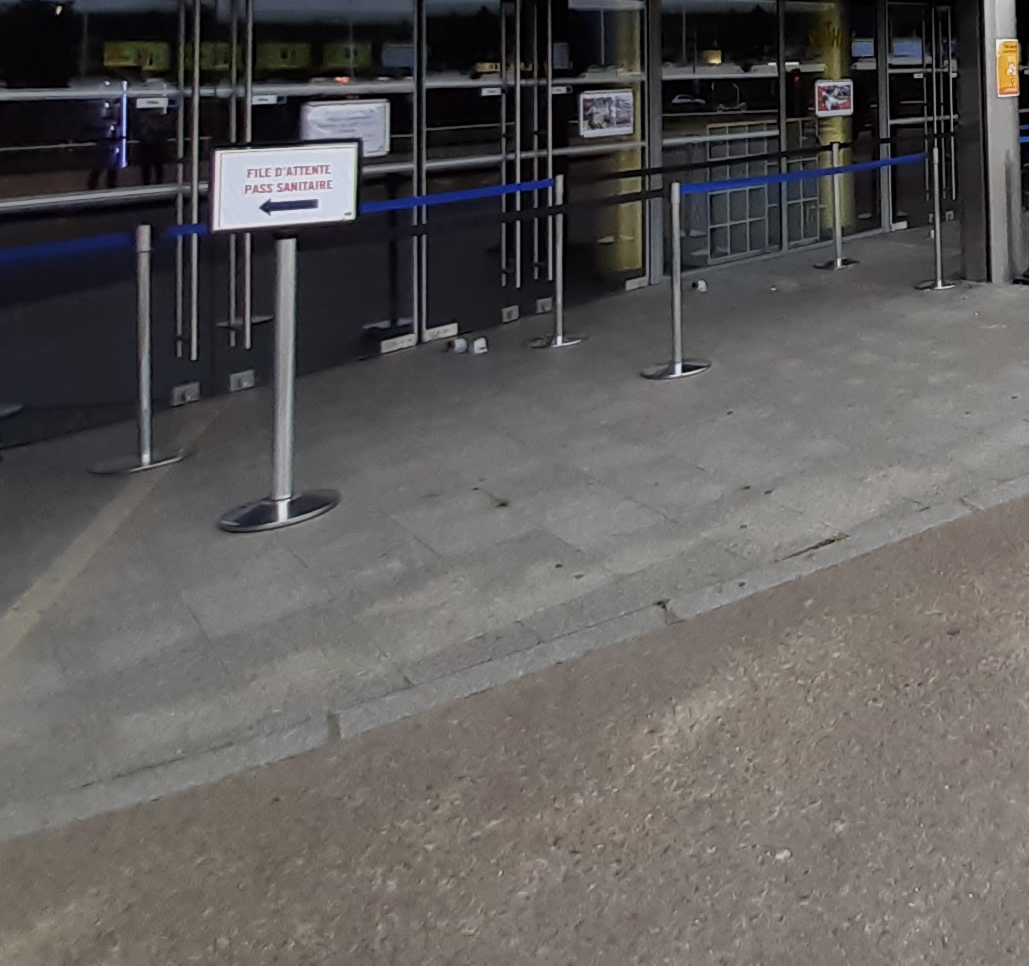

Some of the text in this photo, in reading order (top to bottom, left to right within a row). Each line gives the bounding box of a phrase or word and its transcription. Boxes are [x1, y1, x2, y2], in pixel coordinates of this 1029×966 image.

[246, 164, 332, 179] FILE D'ATTENTE
[244, 179, 334, 195] PASS SANITAIRE
